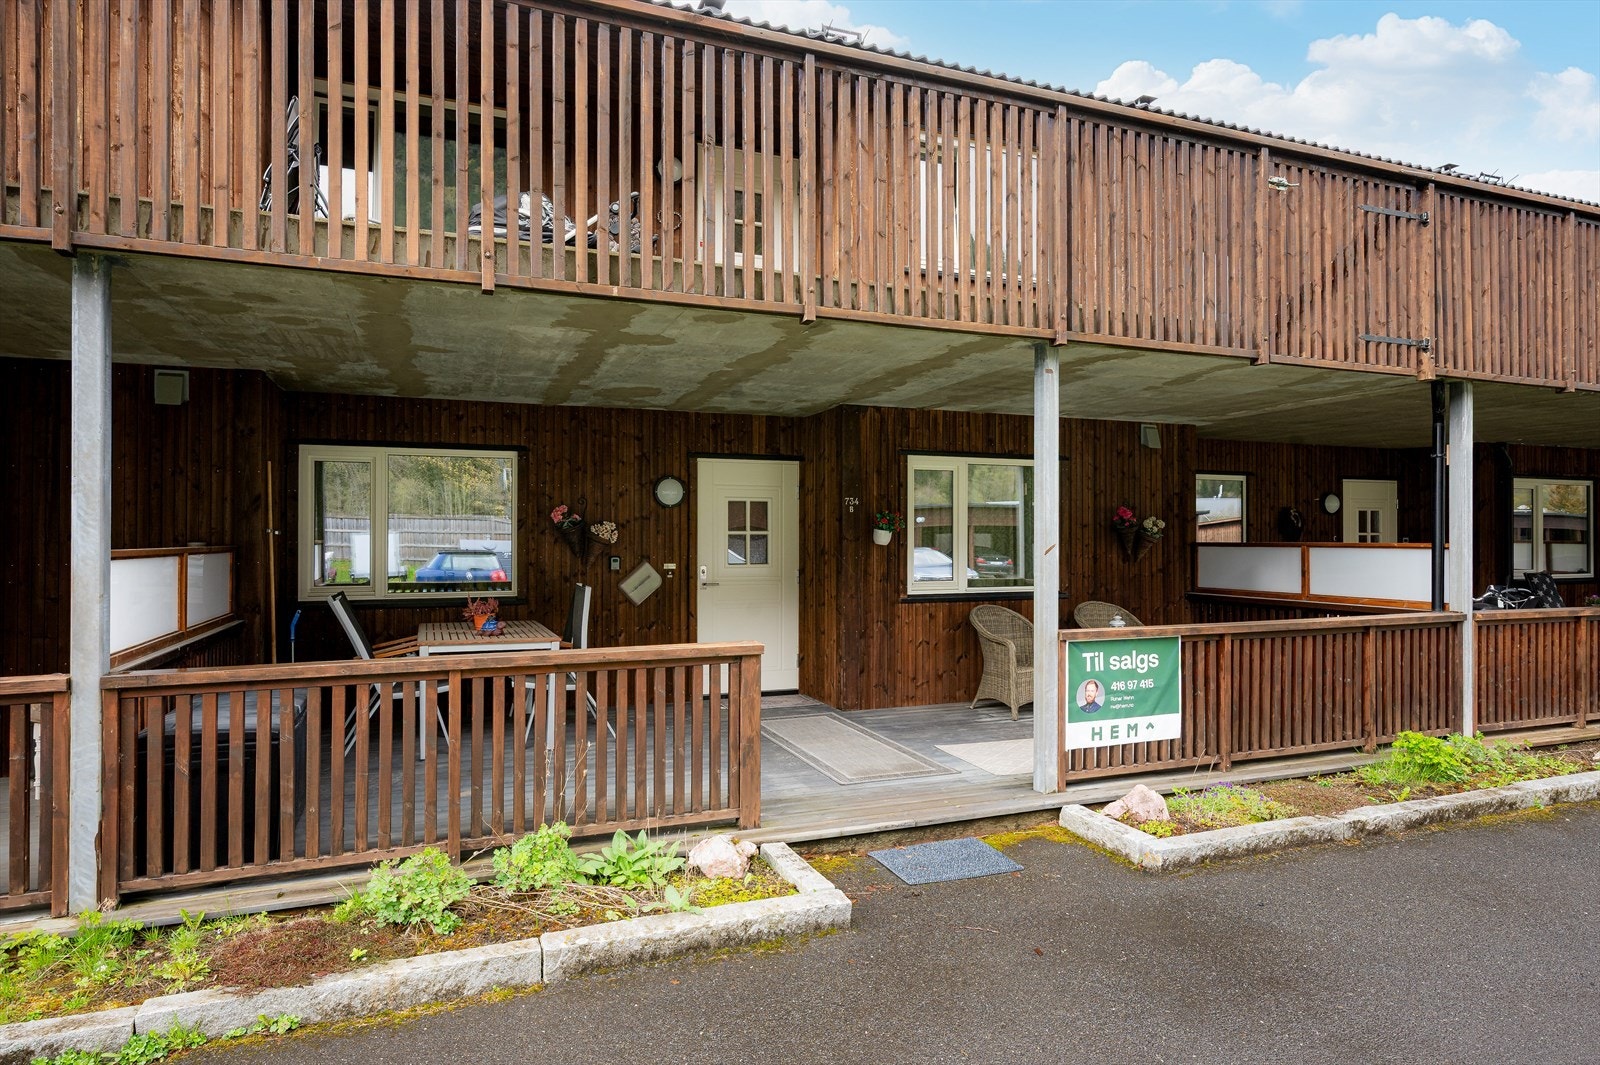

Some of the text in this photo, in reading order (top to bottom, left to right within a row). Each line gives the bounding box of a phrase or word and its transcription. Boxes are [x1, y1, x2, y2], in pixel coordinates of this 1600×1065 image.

[844, 497, 859, 505] 734
[1082, 650, 1159, 674] Til salgs
[1110, 679, 1154, 691] 416 97 415
